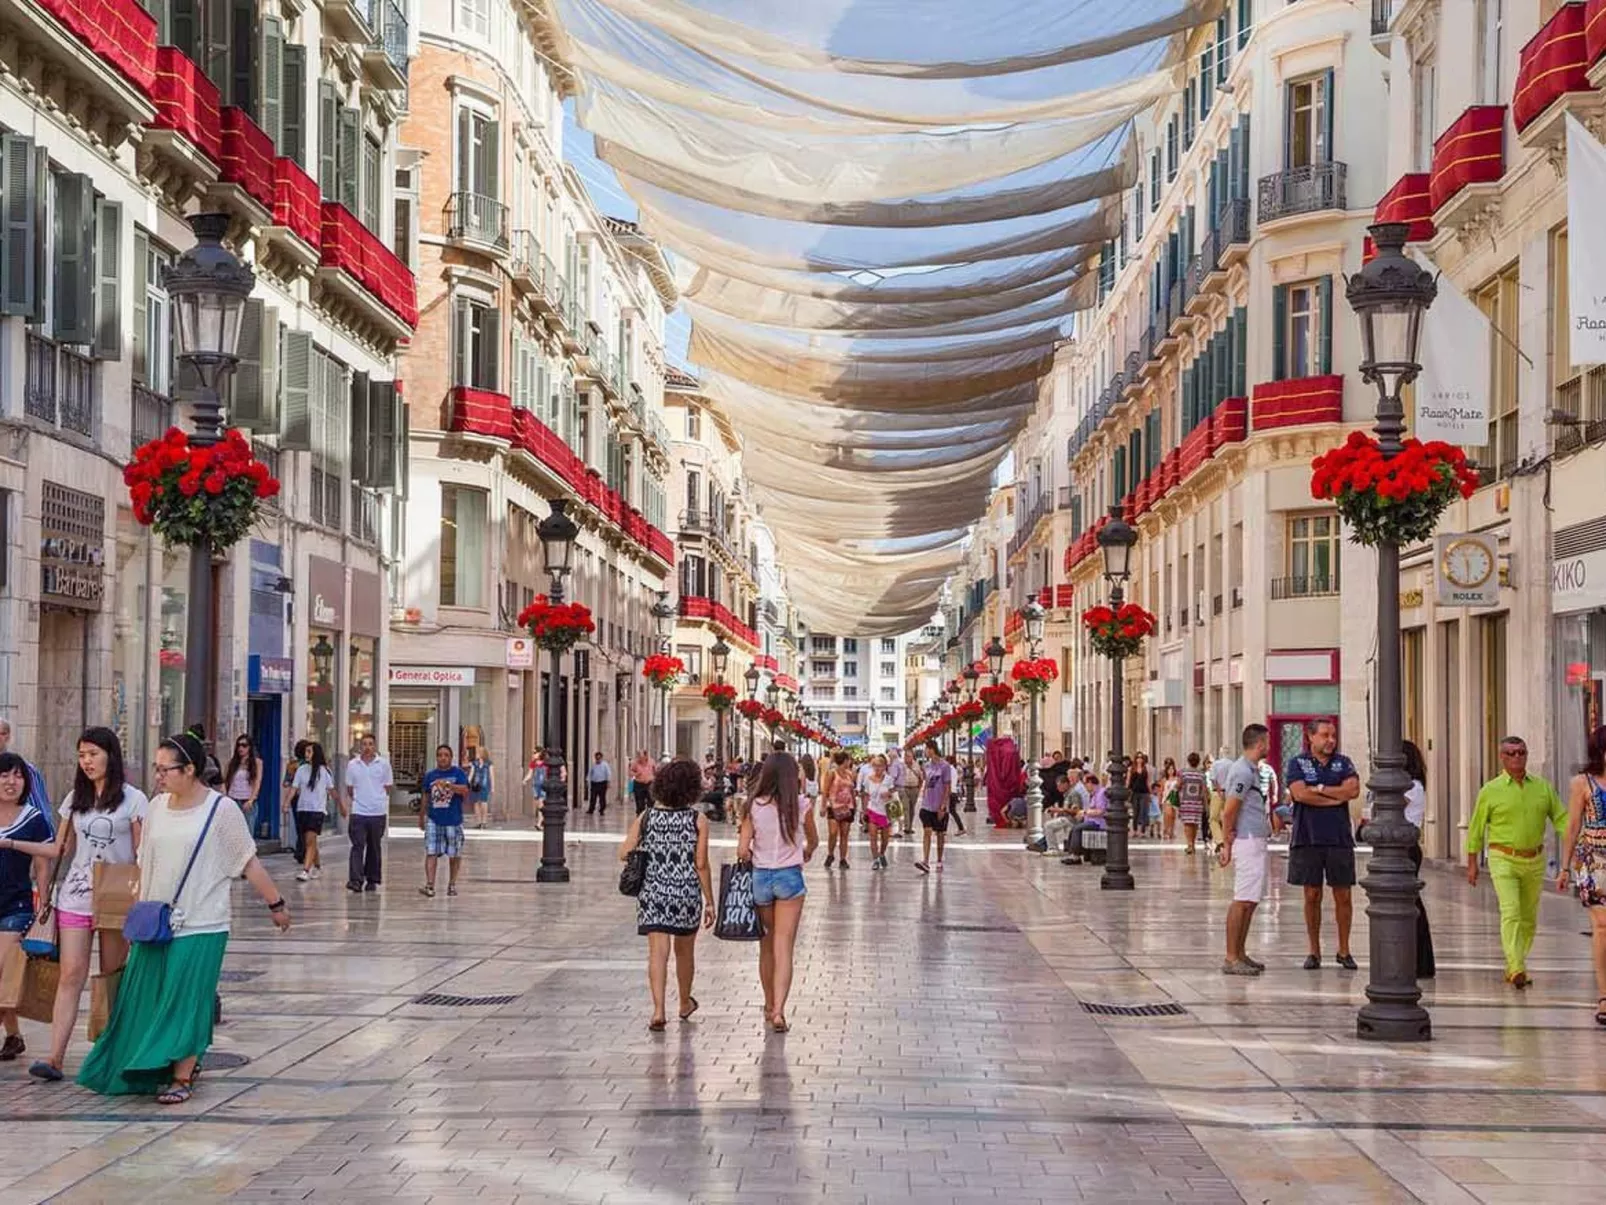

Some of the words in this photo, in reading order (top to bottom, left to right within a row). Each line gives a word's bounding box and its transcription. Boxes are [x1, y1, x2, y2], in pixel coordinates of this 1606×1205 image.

[1552, 559, 1586, 593] KIKO
[1452, 592, 1483, 601] ROLEX
[395, 669, 431, 681] General
[433, 671, 463, 683] Optica
[1235, 782, 1244, 794] 3
